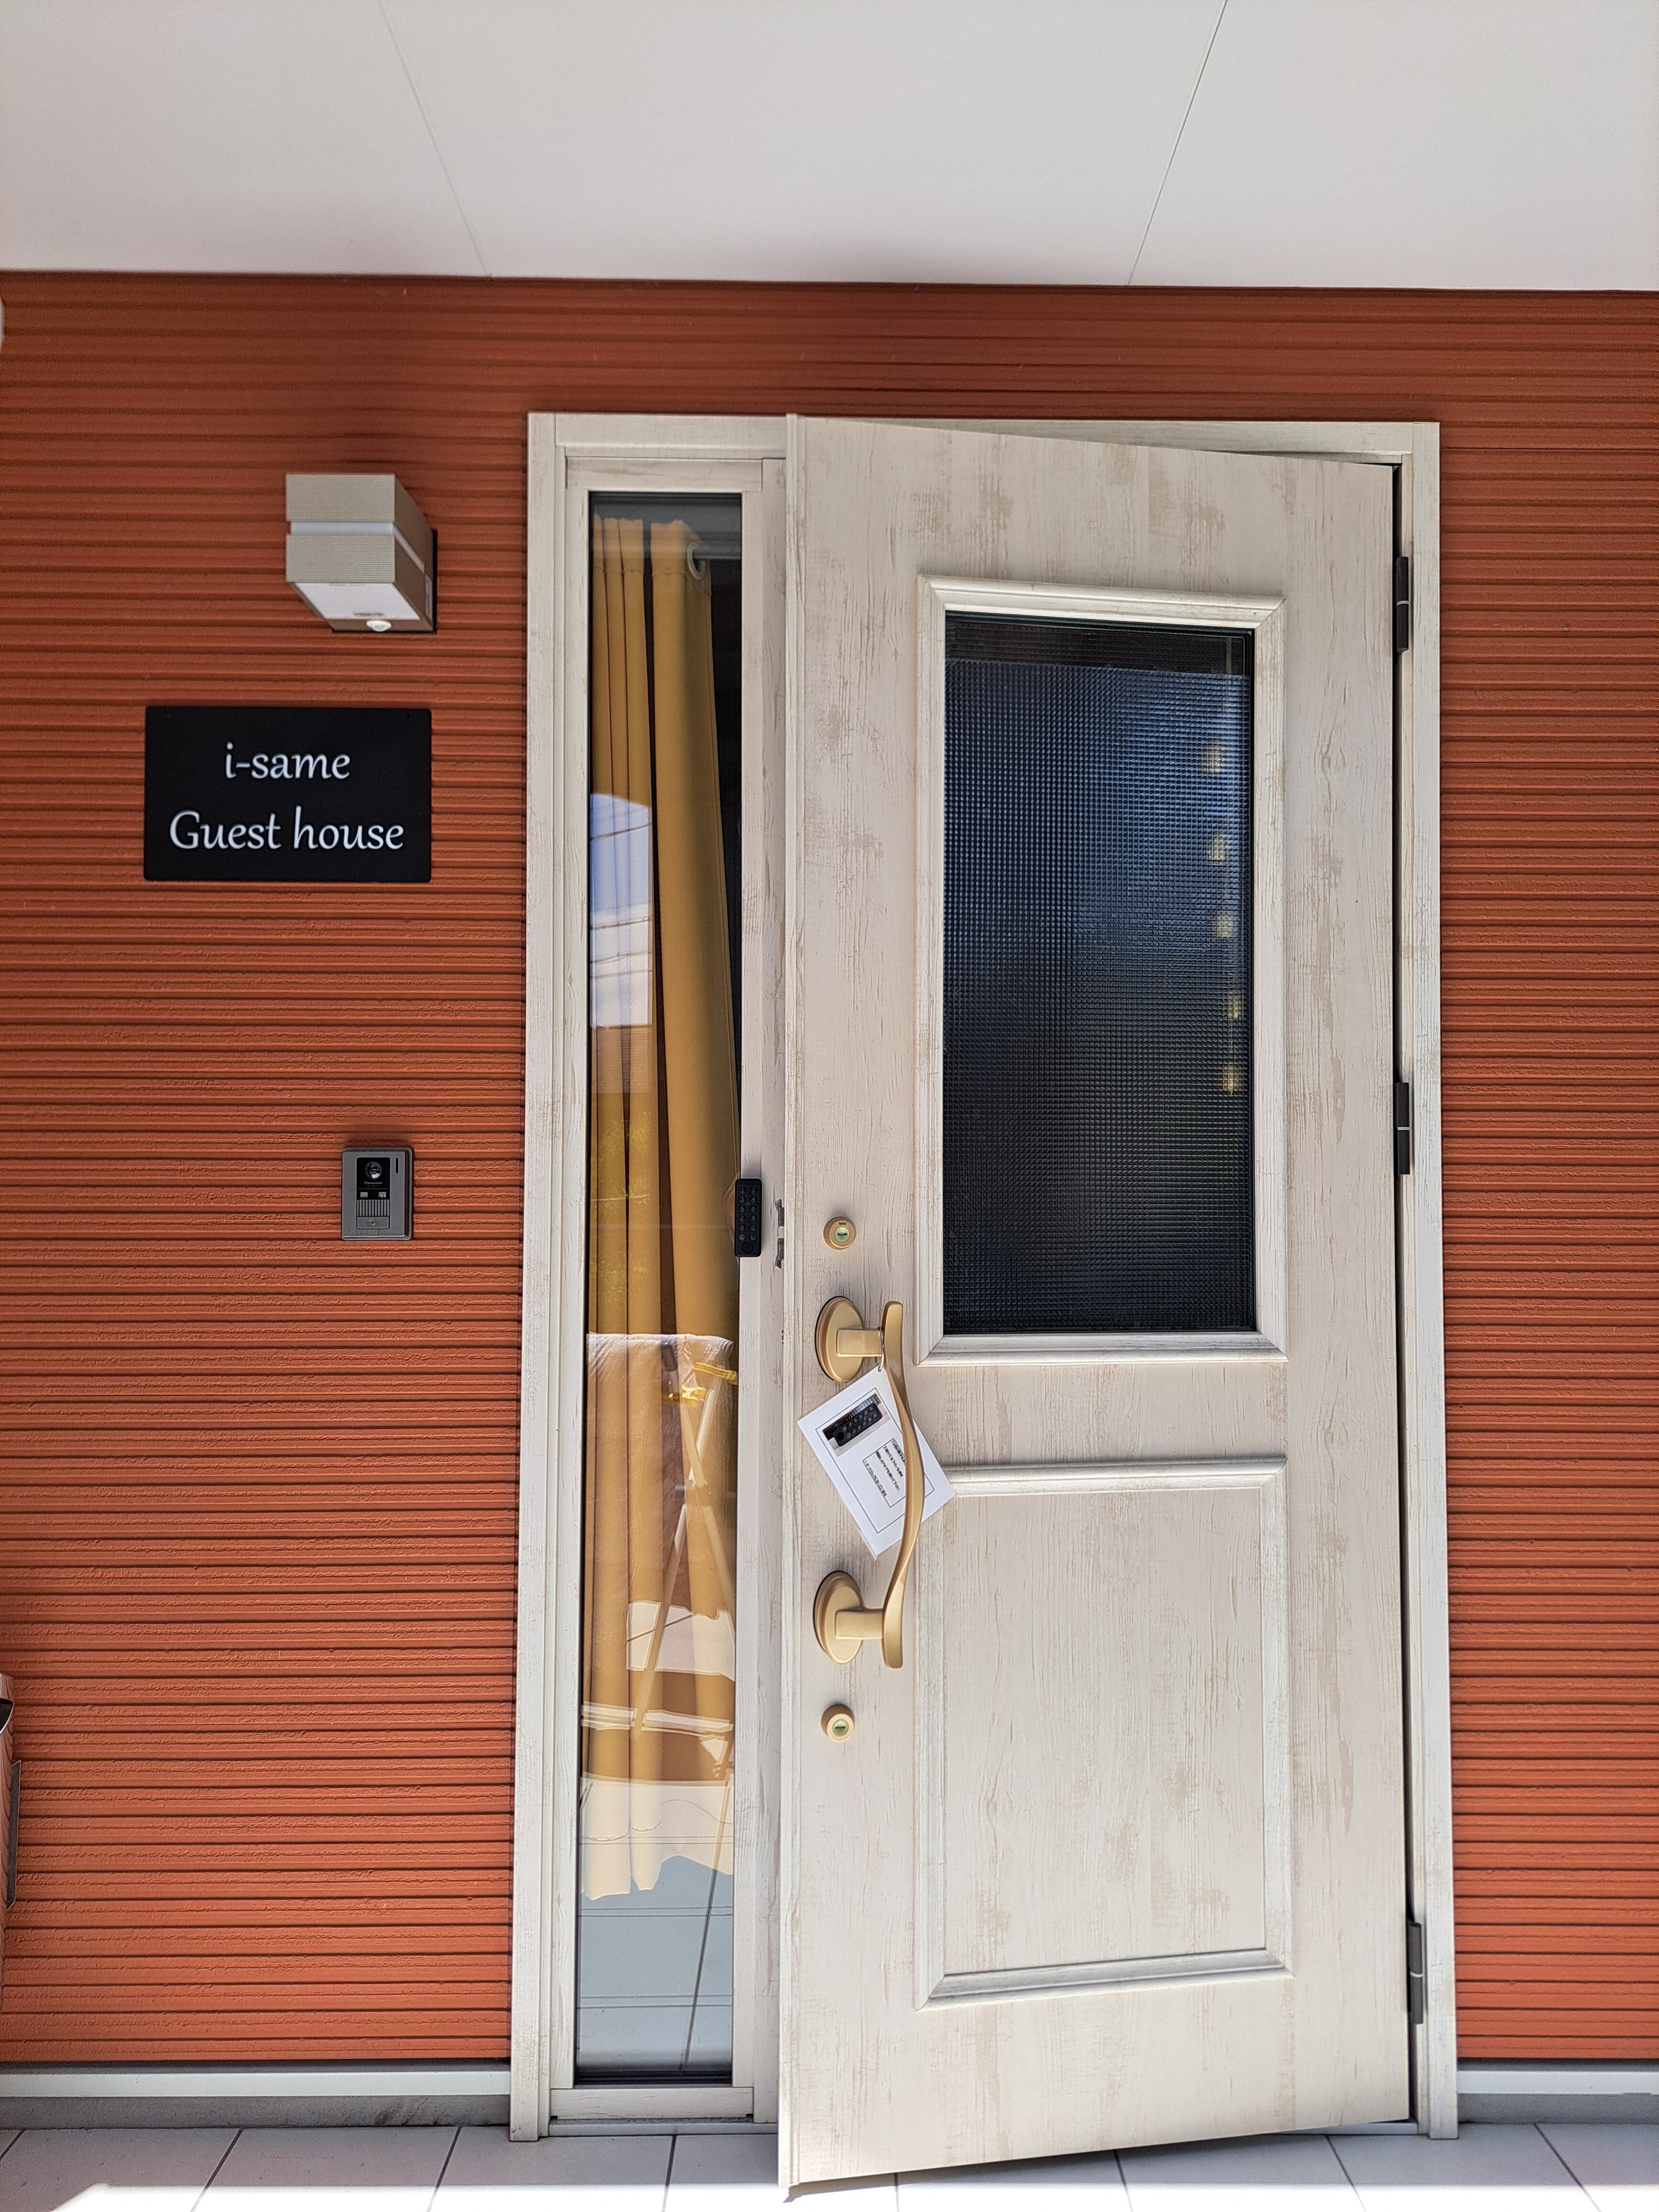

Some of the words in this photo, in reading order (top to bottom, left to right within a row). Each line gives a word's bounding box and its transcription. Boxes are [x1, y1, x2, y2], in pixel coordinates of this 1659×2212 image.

[225, 741, 351, 779] i-same
[169, 809, 281, 849] Guest
[293, 805, 404, 849] house
